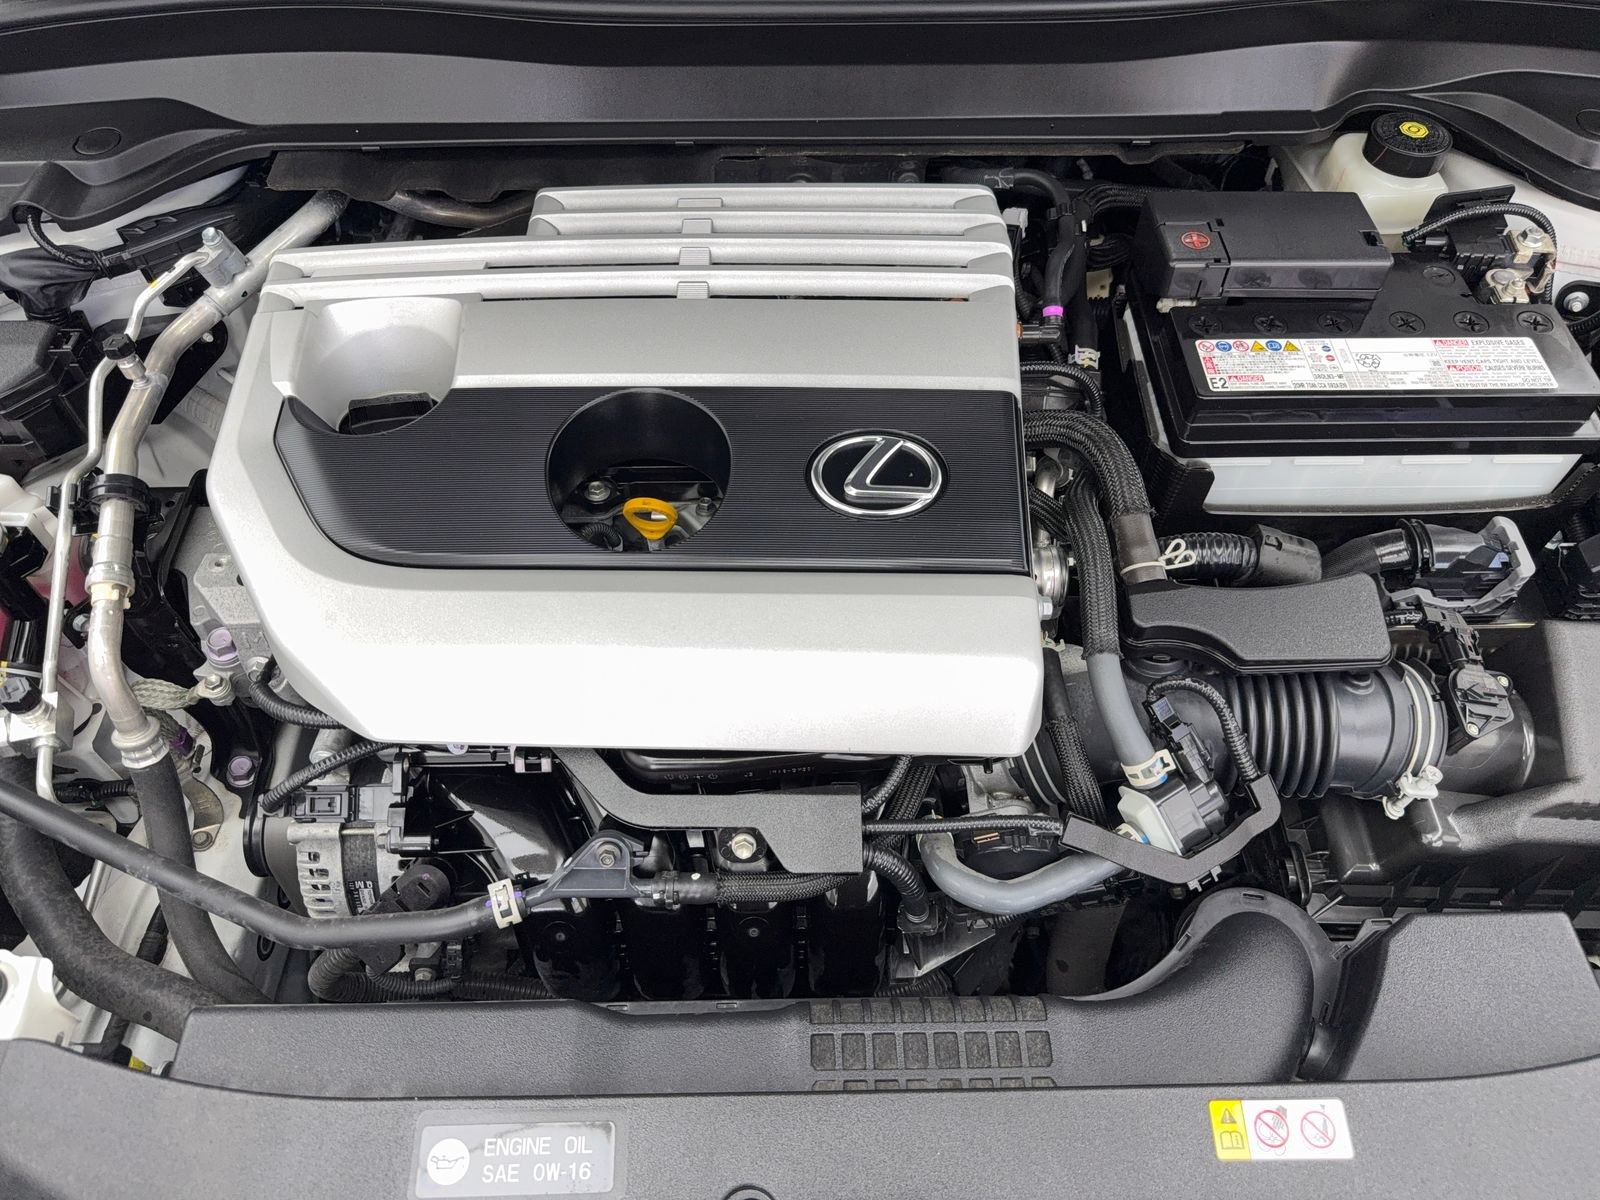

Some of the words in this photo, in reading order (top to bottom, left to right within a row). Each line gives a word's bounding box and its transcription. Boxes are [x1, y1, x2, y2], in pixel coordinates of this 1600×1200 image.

[1208, 377, 1229, 389] E2
[483, 1137, 551, 1156] ENGINE
[564, 1136, 592, 1154] OIL
[481, 1163, 520, 1183] SAE
[533, 1161, 591, 1181] 0W-16
